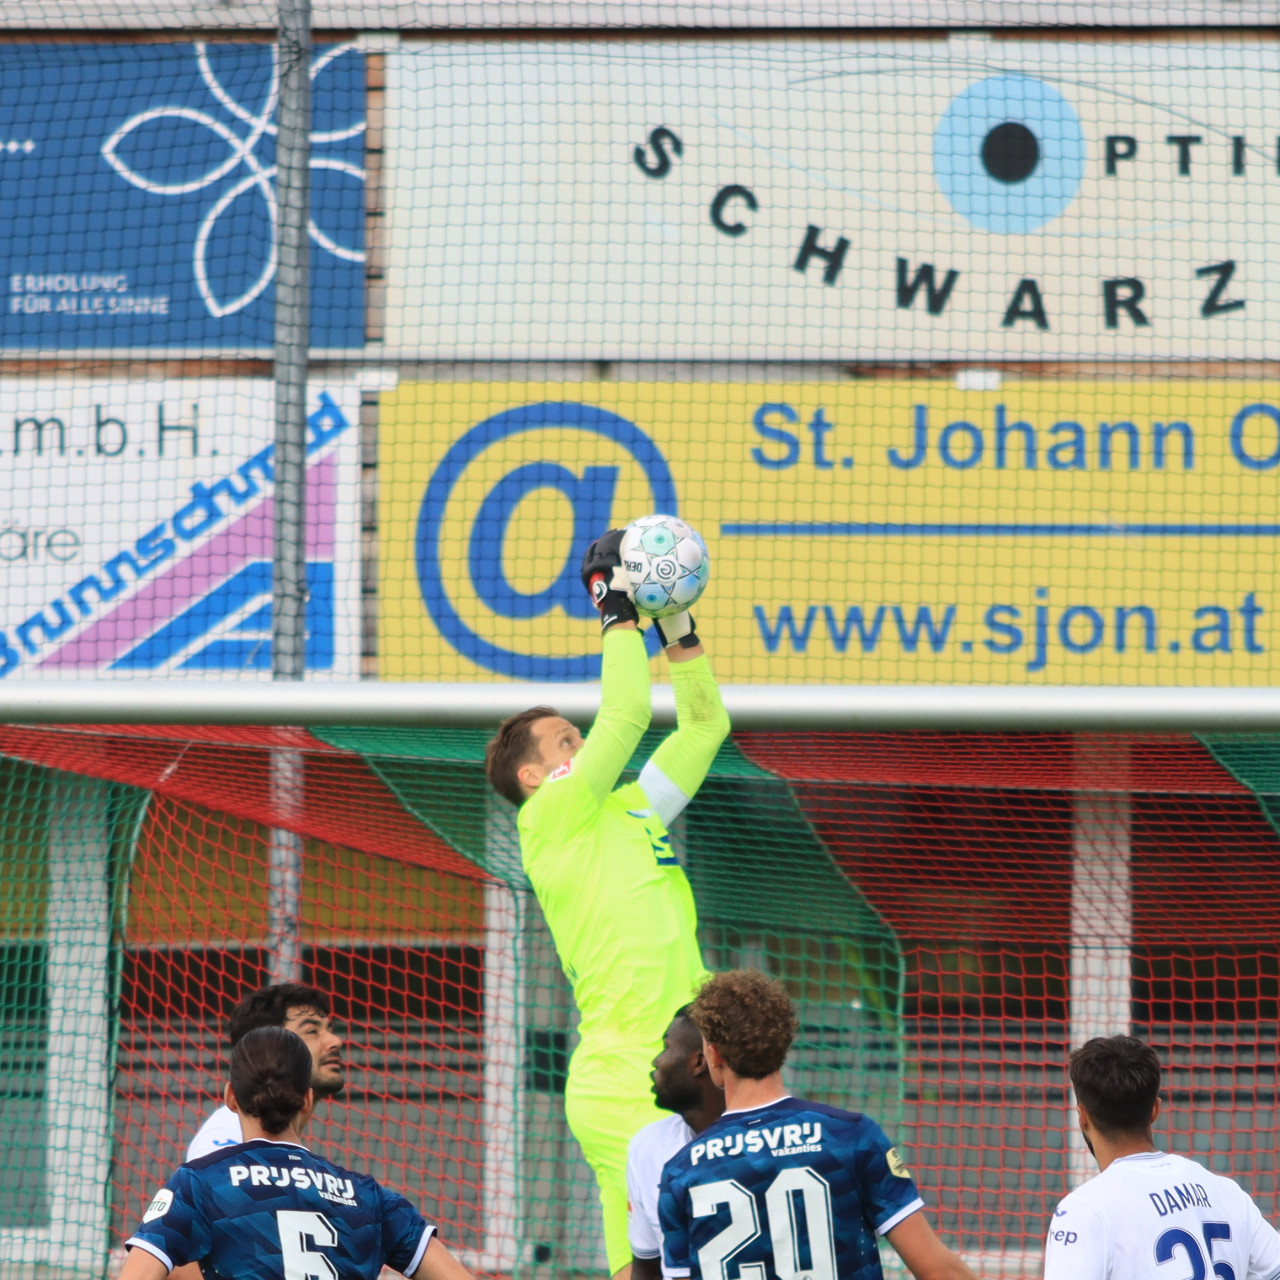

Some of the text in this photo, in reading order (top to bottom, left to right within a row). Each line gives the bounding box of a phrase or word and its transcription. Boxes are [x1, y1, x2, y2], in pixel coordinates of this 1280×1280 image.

[633, 126, 1246, 331] SCHWARZ
[11, 274, 128, 293] ERHOLUNG
[11, 297, 169, 315] FÜR ALLE SINNE
[751, 403, 853, 472] St.
[888, 403, 1194, 472] Johann
[754, 587, 1263, 672] www.sjon.at
[771, 1143, 822, 1157] vakanties
[318, 1190, 358, 1207] vakanties
[1149, 1183, 1212, 1217] DAMAR
